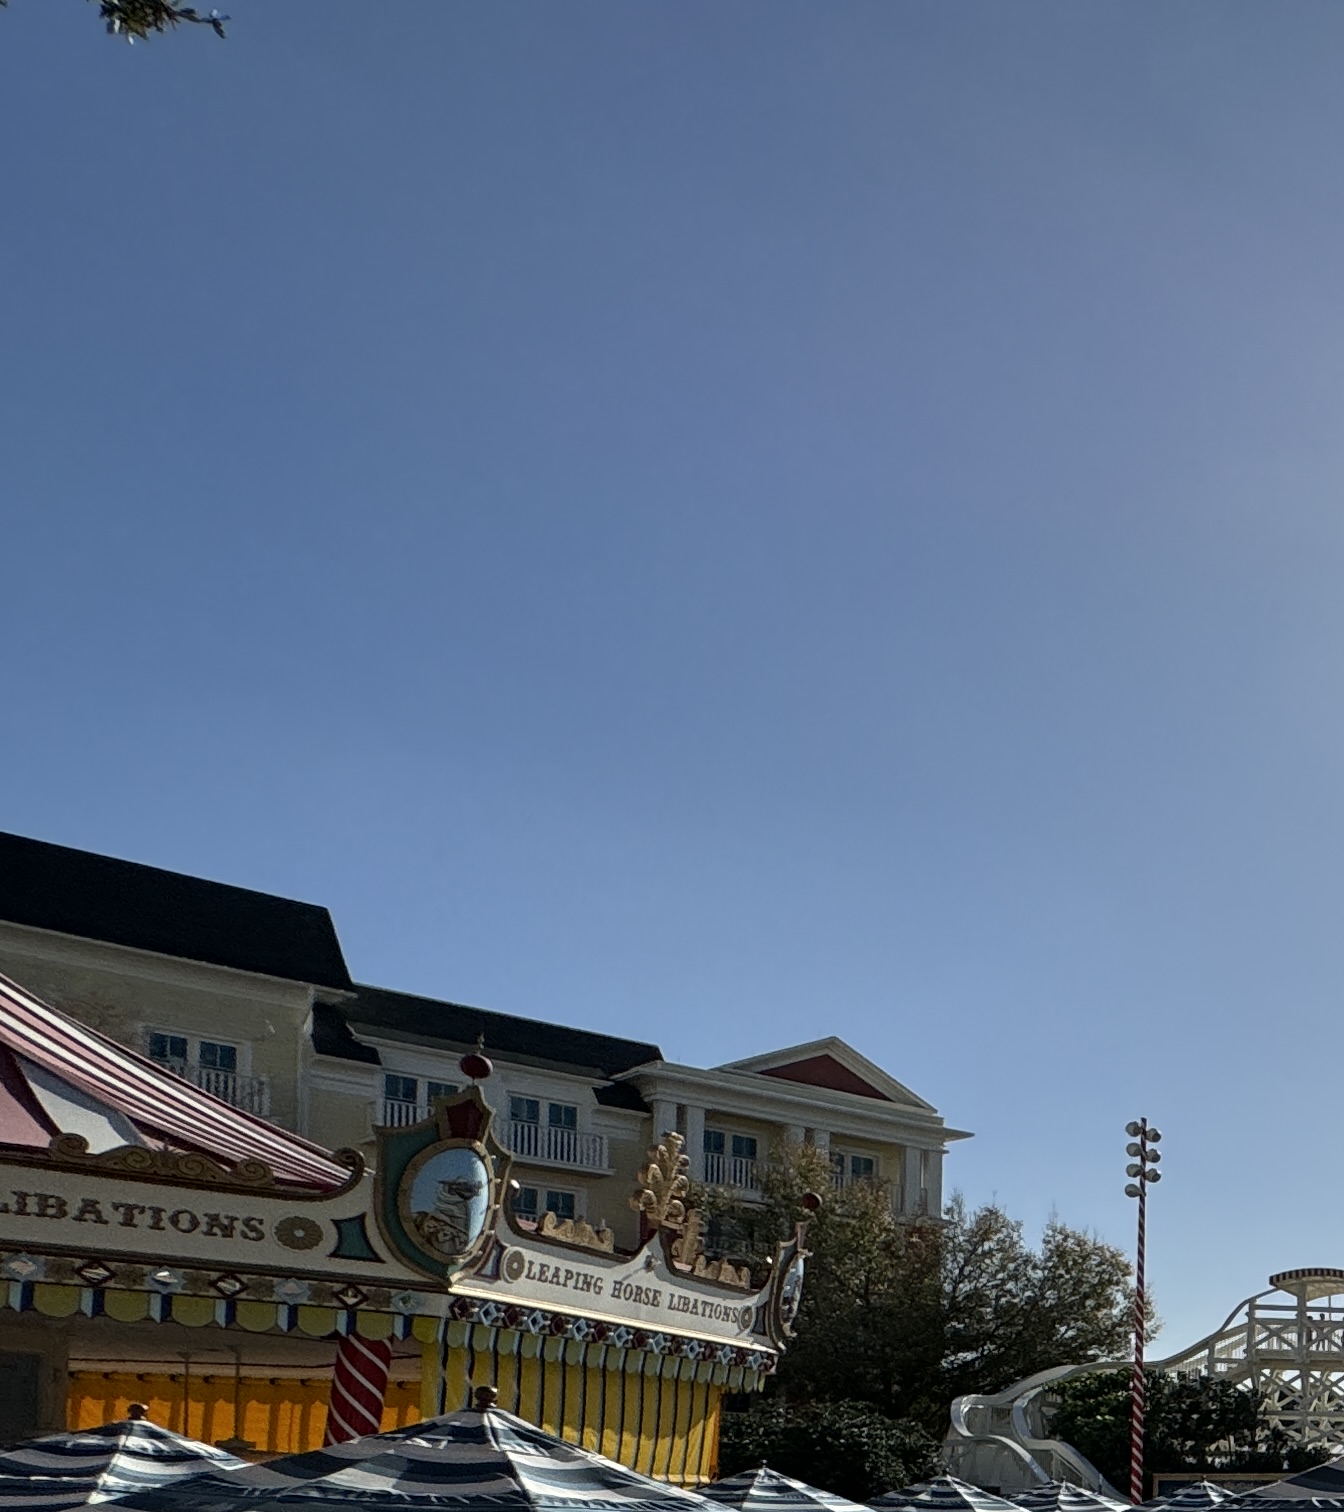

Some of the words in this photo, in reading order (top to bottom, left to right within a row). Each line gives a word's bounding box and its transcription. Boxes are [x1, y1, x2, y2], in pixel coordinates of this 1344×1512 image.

[0, 1190, 265, 1242] IBATIONS
[525, 1260, 604, 1295] LEAPING
[611, 1280, 662, 1307] HORSE
[668, 1293, 739, 1324] LIBATIONS
